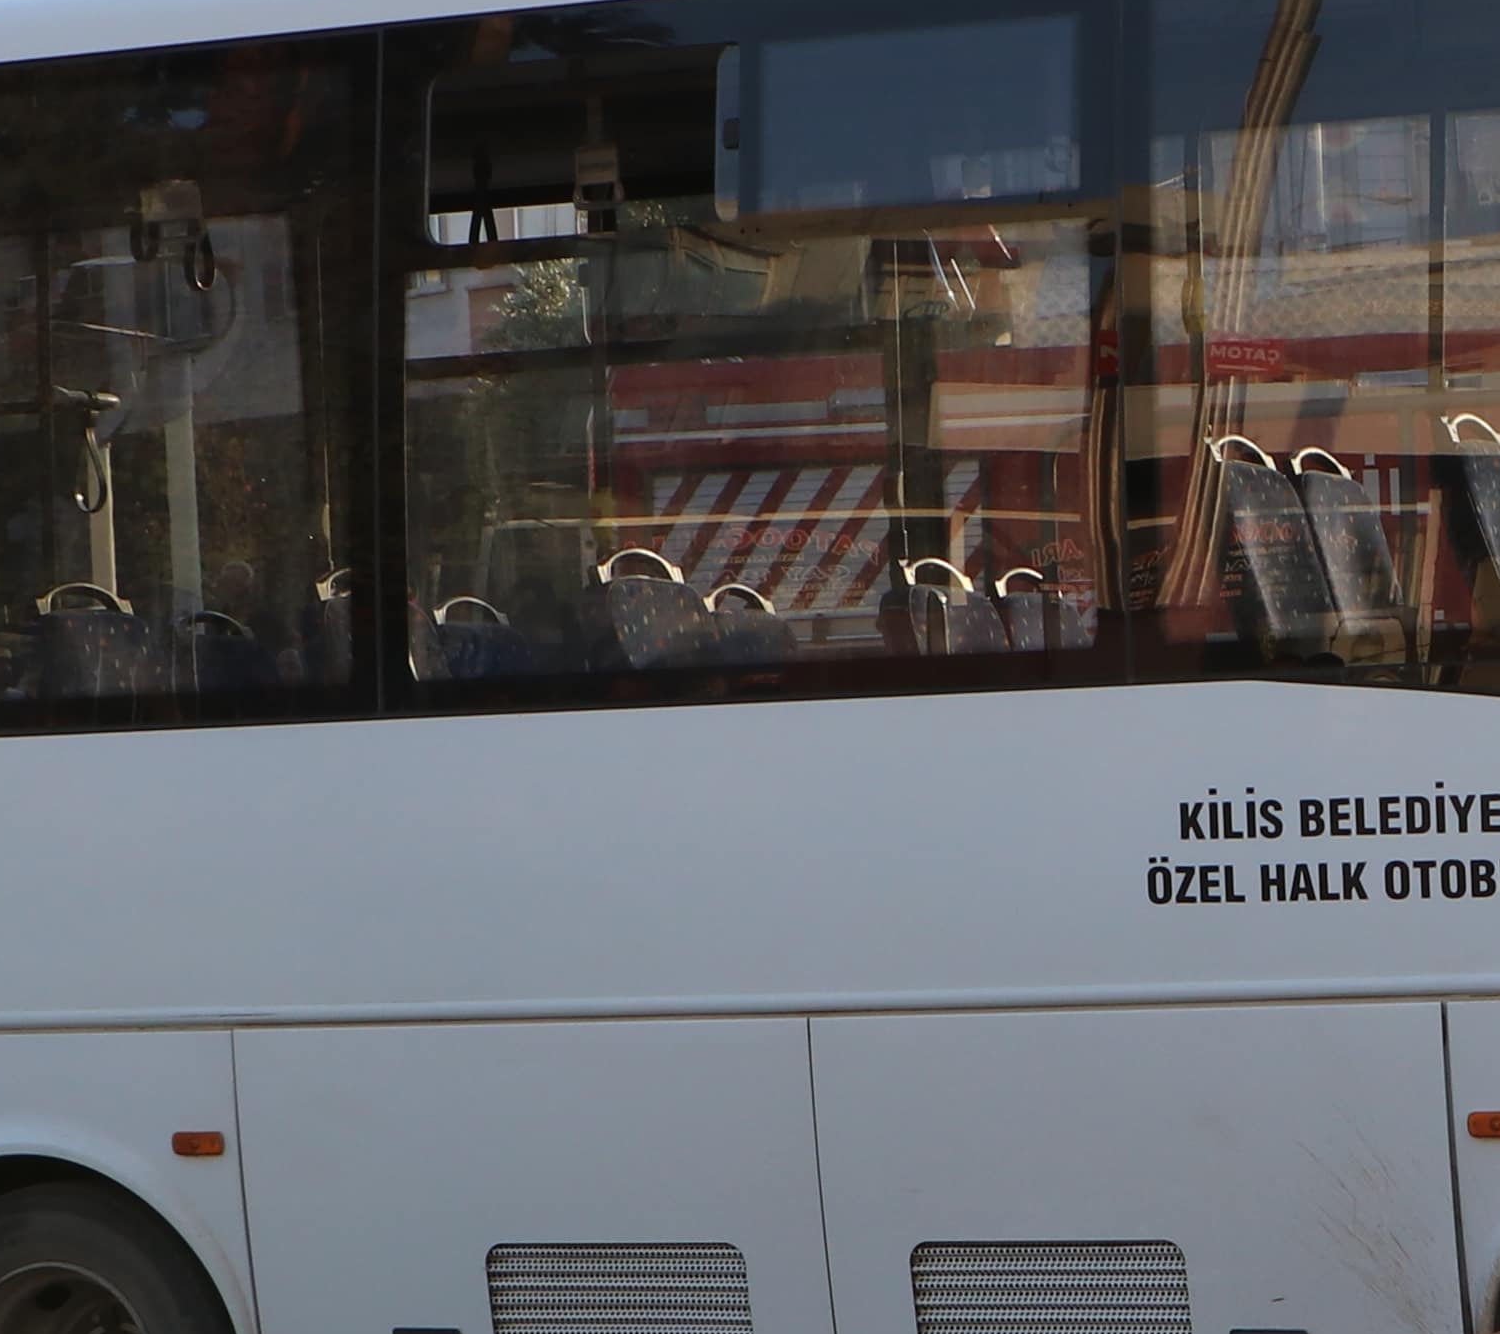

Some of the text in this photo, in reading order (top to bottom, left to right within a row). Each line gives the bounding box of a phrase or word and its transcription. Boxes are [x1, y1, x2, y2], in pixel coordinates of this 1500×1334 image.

[1180, 787, 1283, 839] KİLİS
[1147, 856, 1246, 905] ÖZEL
[1260, 862, 1368, 903] HALK
